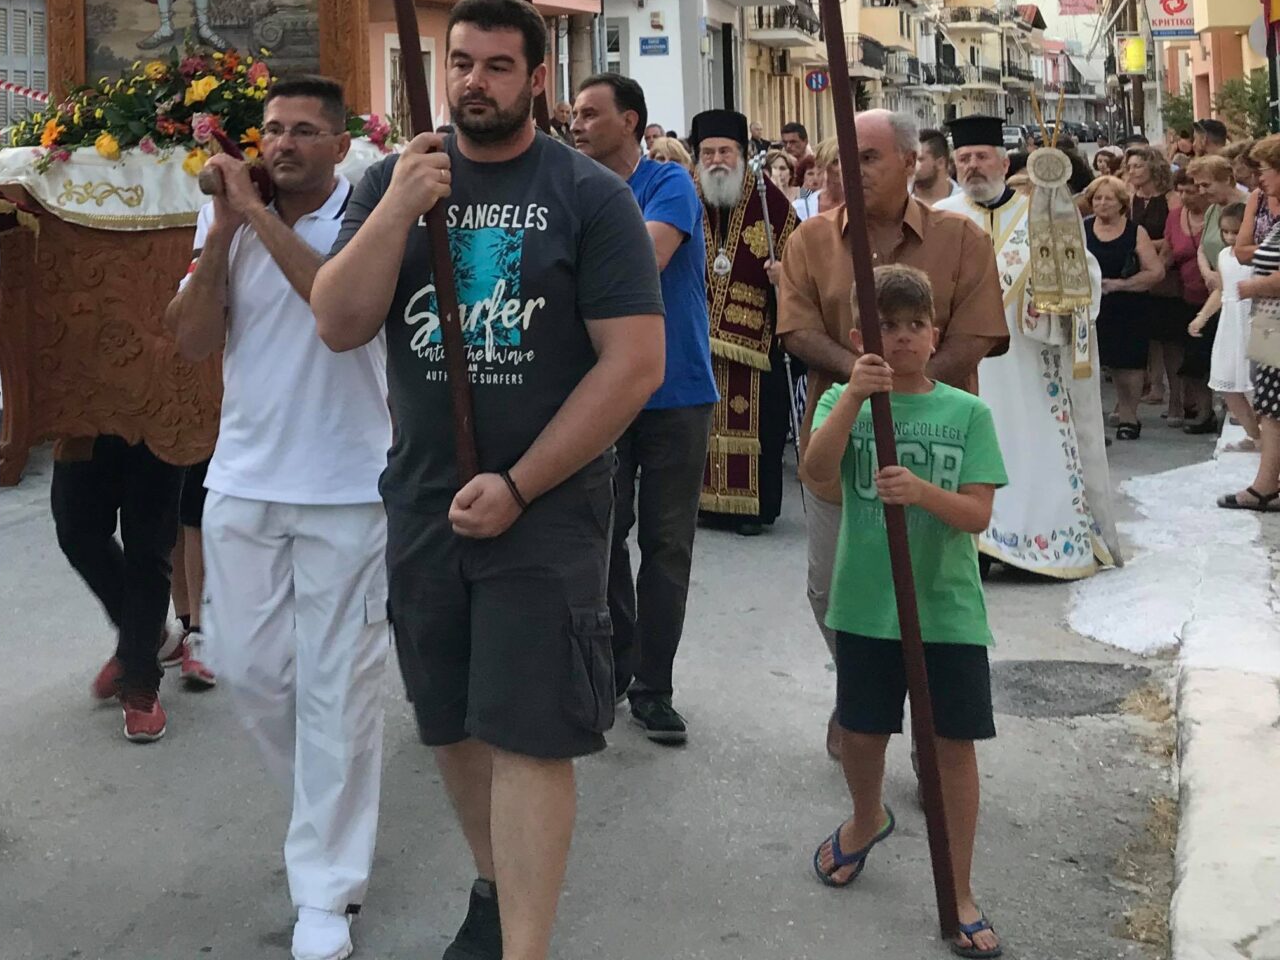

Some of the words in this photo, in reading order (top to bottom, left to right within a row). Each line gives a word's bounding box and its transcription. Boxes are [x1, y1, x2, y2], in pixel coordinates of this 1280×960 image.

[460, 203, 549, 231] ANGELES
[479, 373, 524, 385] SURFERS
[913, 421, 962, 441] COLLEGE
